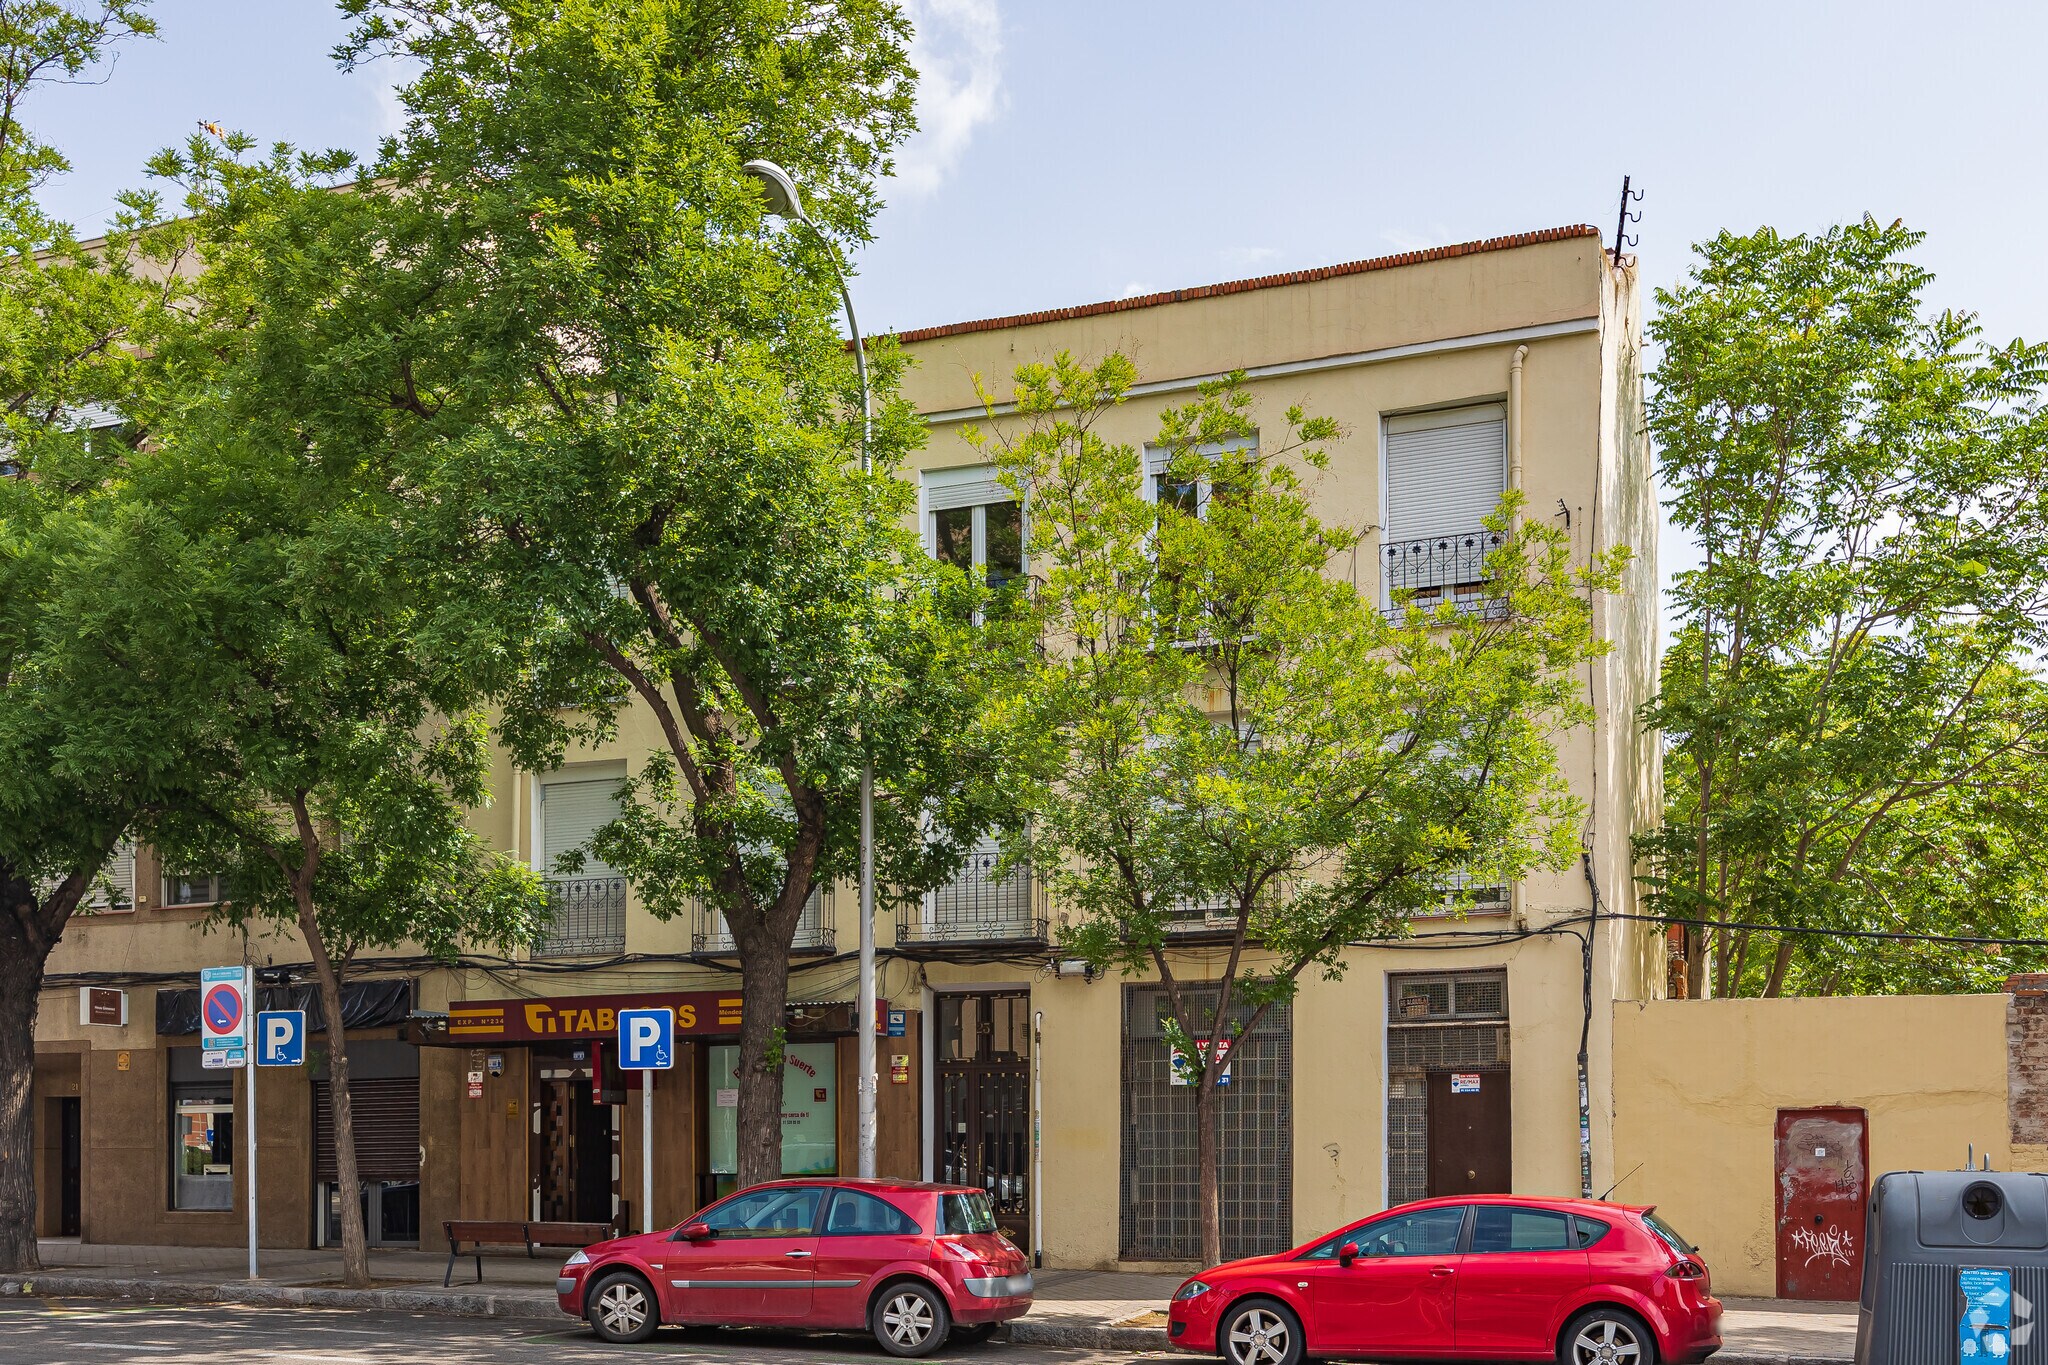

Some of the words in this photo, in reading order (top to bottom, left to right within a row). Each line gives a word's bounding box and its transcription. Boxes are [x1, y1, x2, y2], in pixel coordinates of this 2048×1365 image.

[559, 1004, 697, 1033] TABS
[977, 1022, 990, 1034] 25
[267, 1018, 294, 1060] P
[630, 1017, 661, 1062] P
[789, 1054, 816, 1078] Suerte
